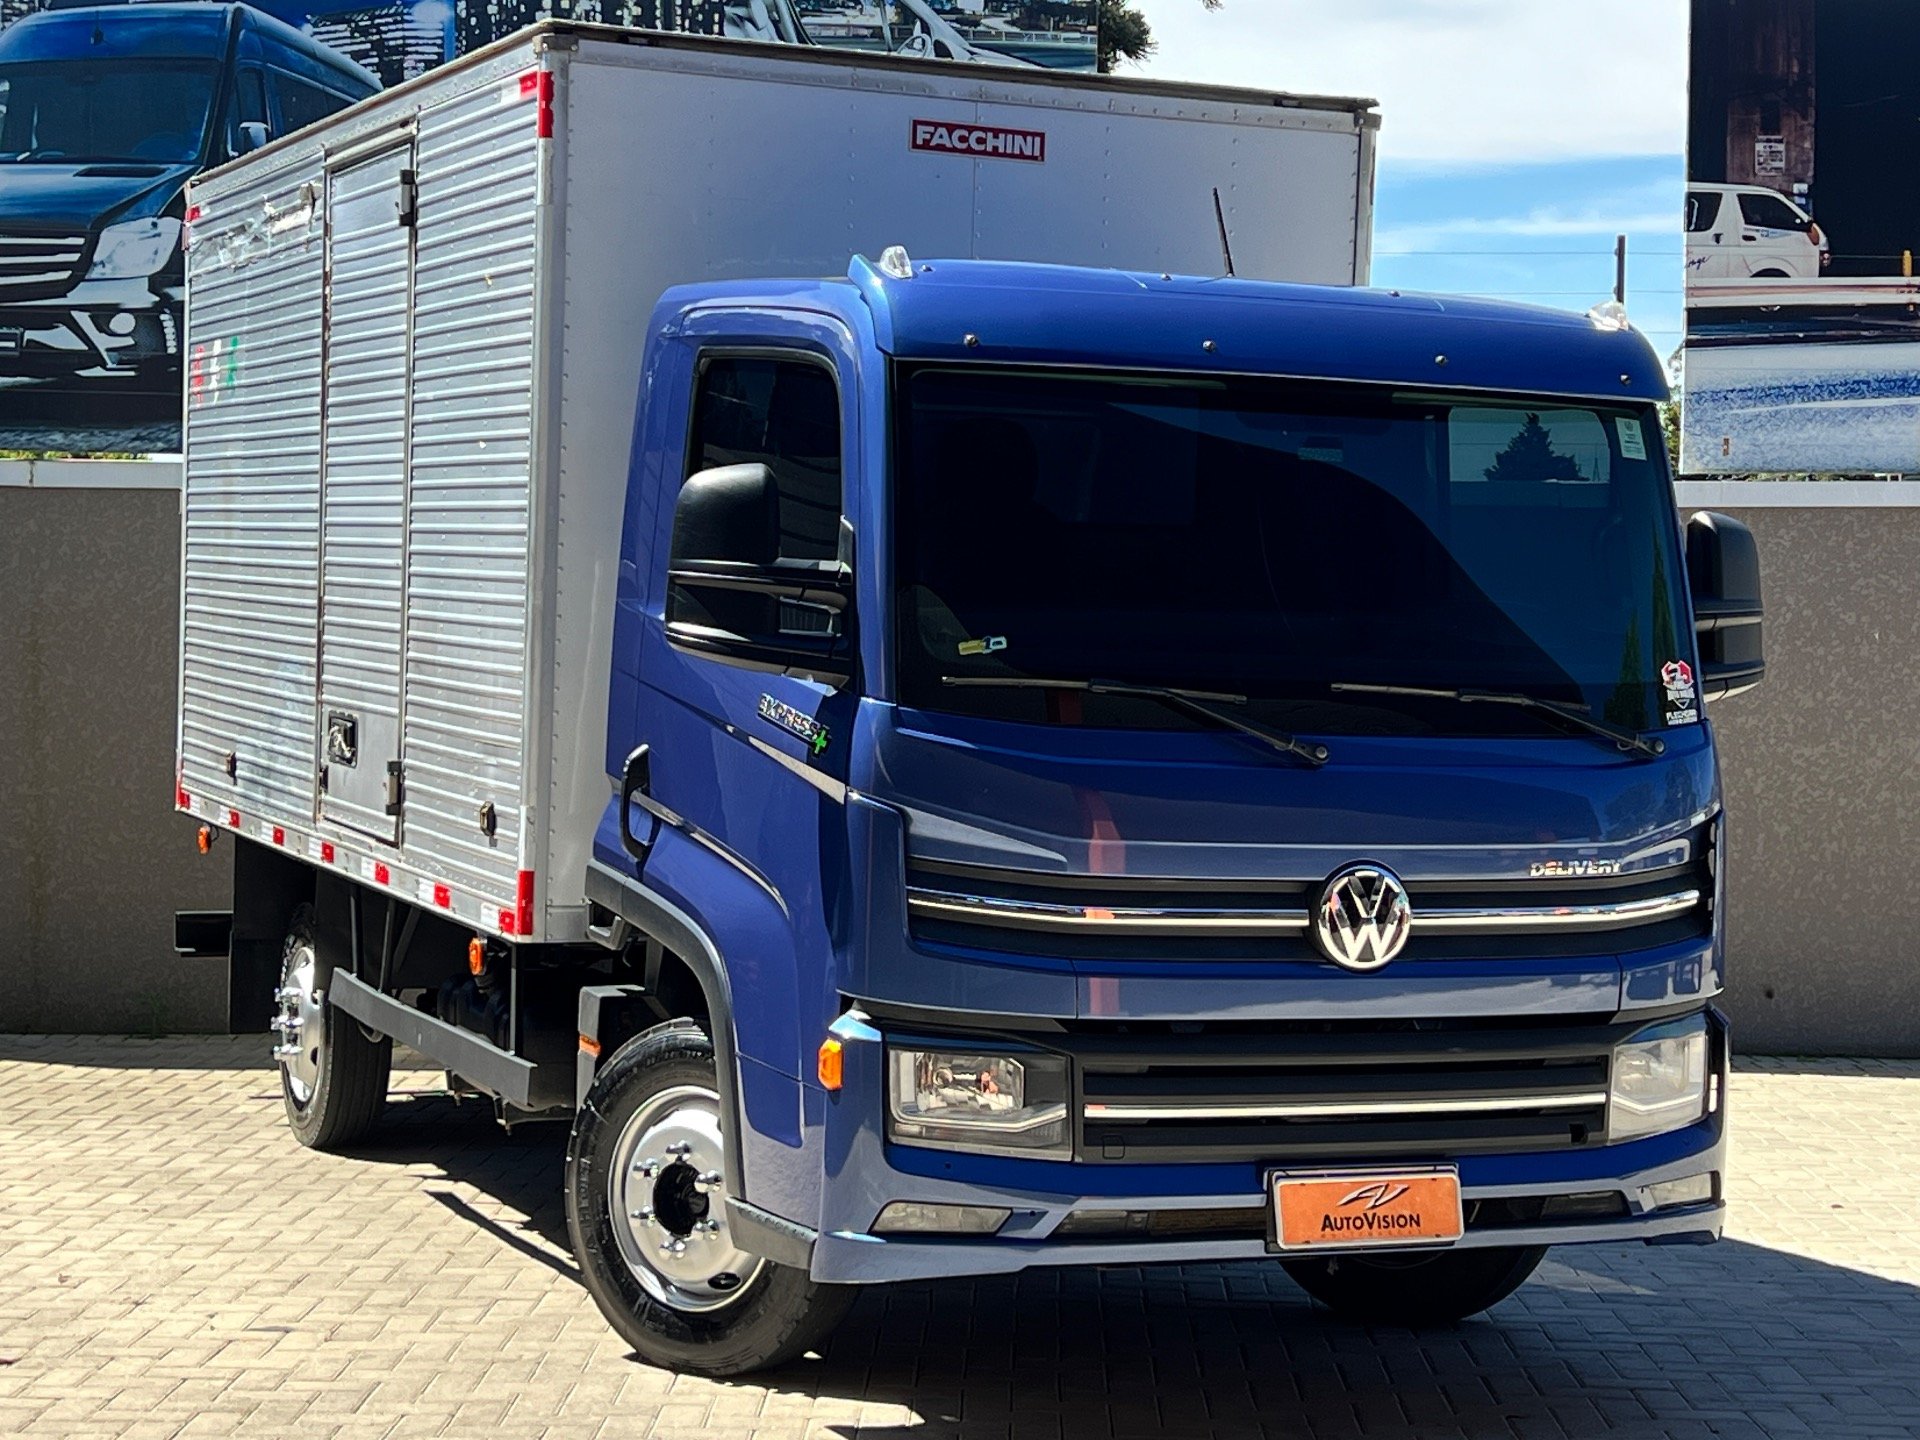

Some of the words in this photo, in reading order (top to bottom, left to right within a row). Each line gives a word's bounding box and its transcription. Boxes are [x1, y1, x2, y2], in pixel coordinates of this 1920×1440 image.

[916, 124, 1041, 157] FACCHINI
[1530, 859, 1621, 877] DELIVERY
[1325, 871, 1404, 965] VW
